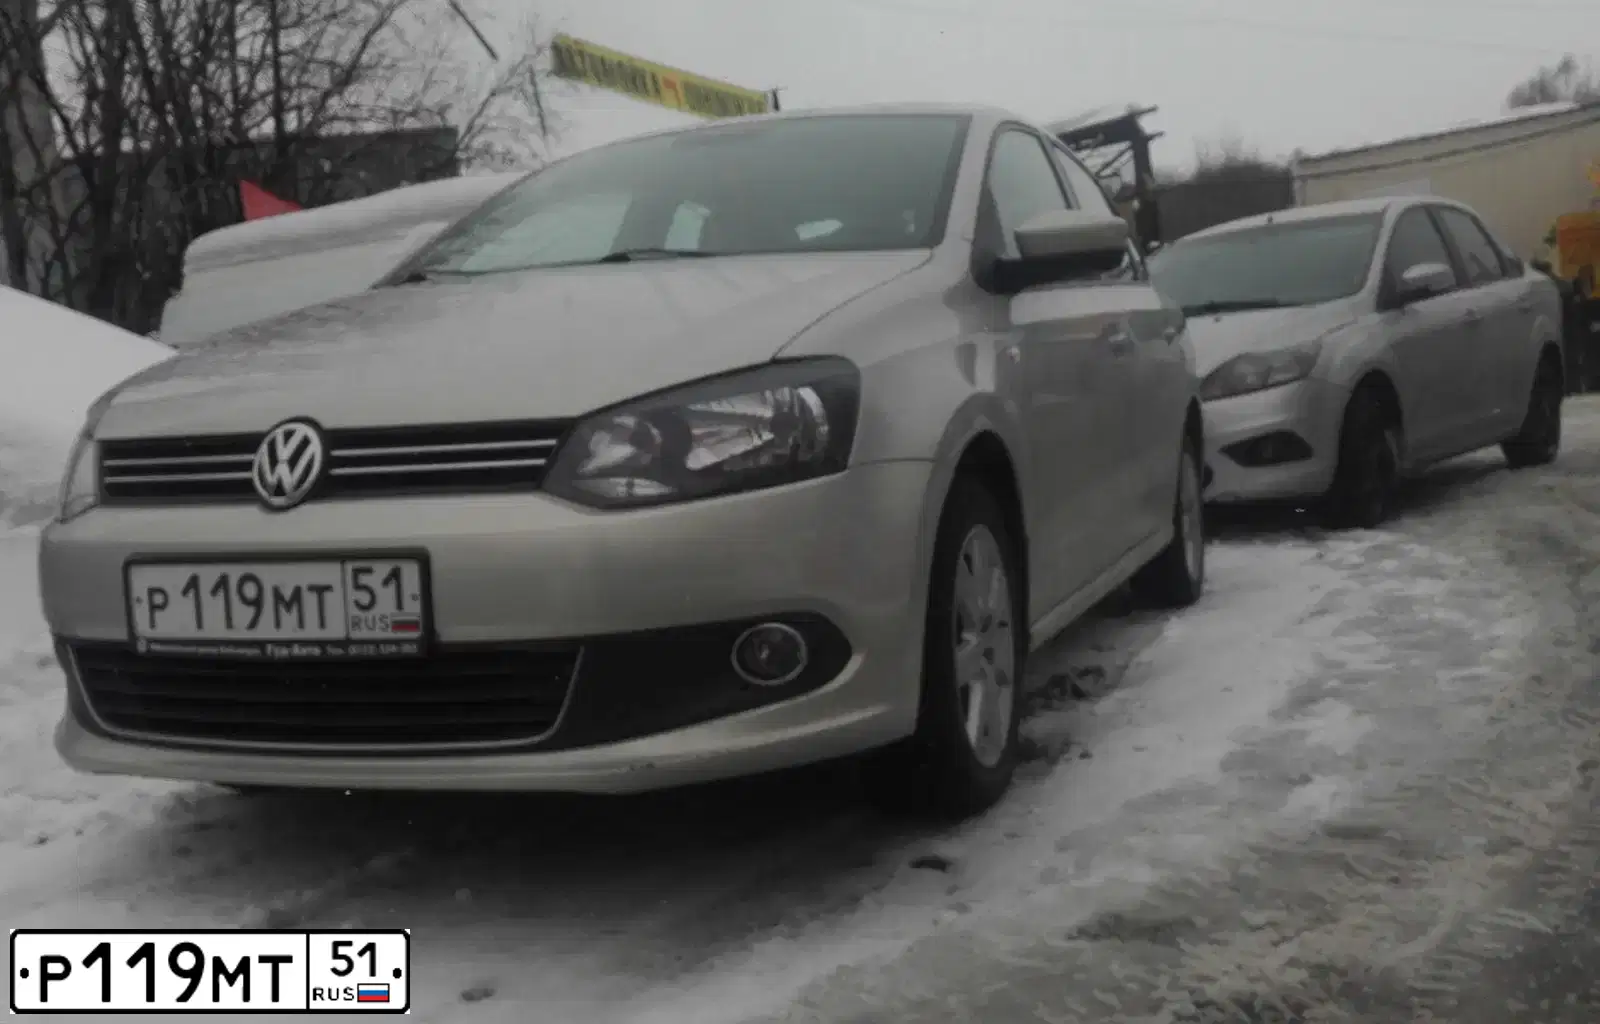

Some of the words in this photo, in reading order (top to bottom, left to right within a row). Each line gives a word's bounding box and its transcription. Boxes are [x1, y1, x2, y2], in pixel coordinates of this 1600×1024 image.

[253, 423, 322, 505] VW
[352, 565, 404, 613] 51
[351, 614, 390, 632] RUS
